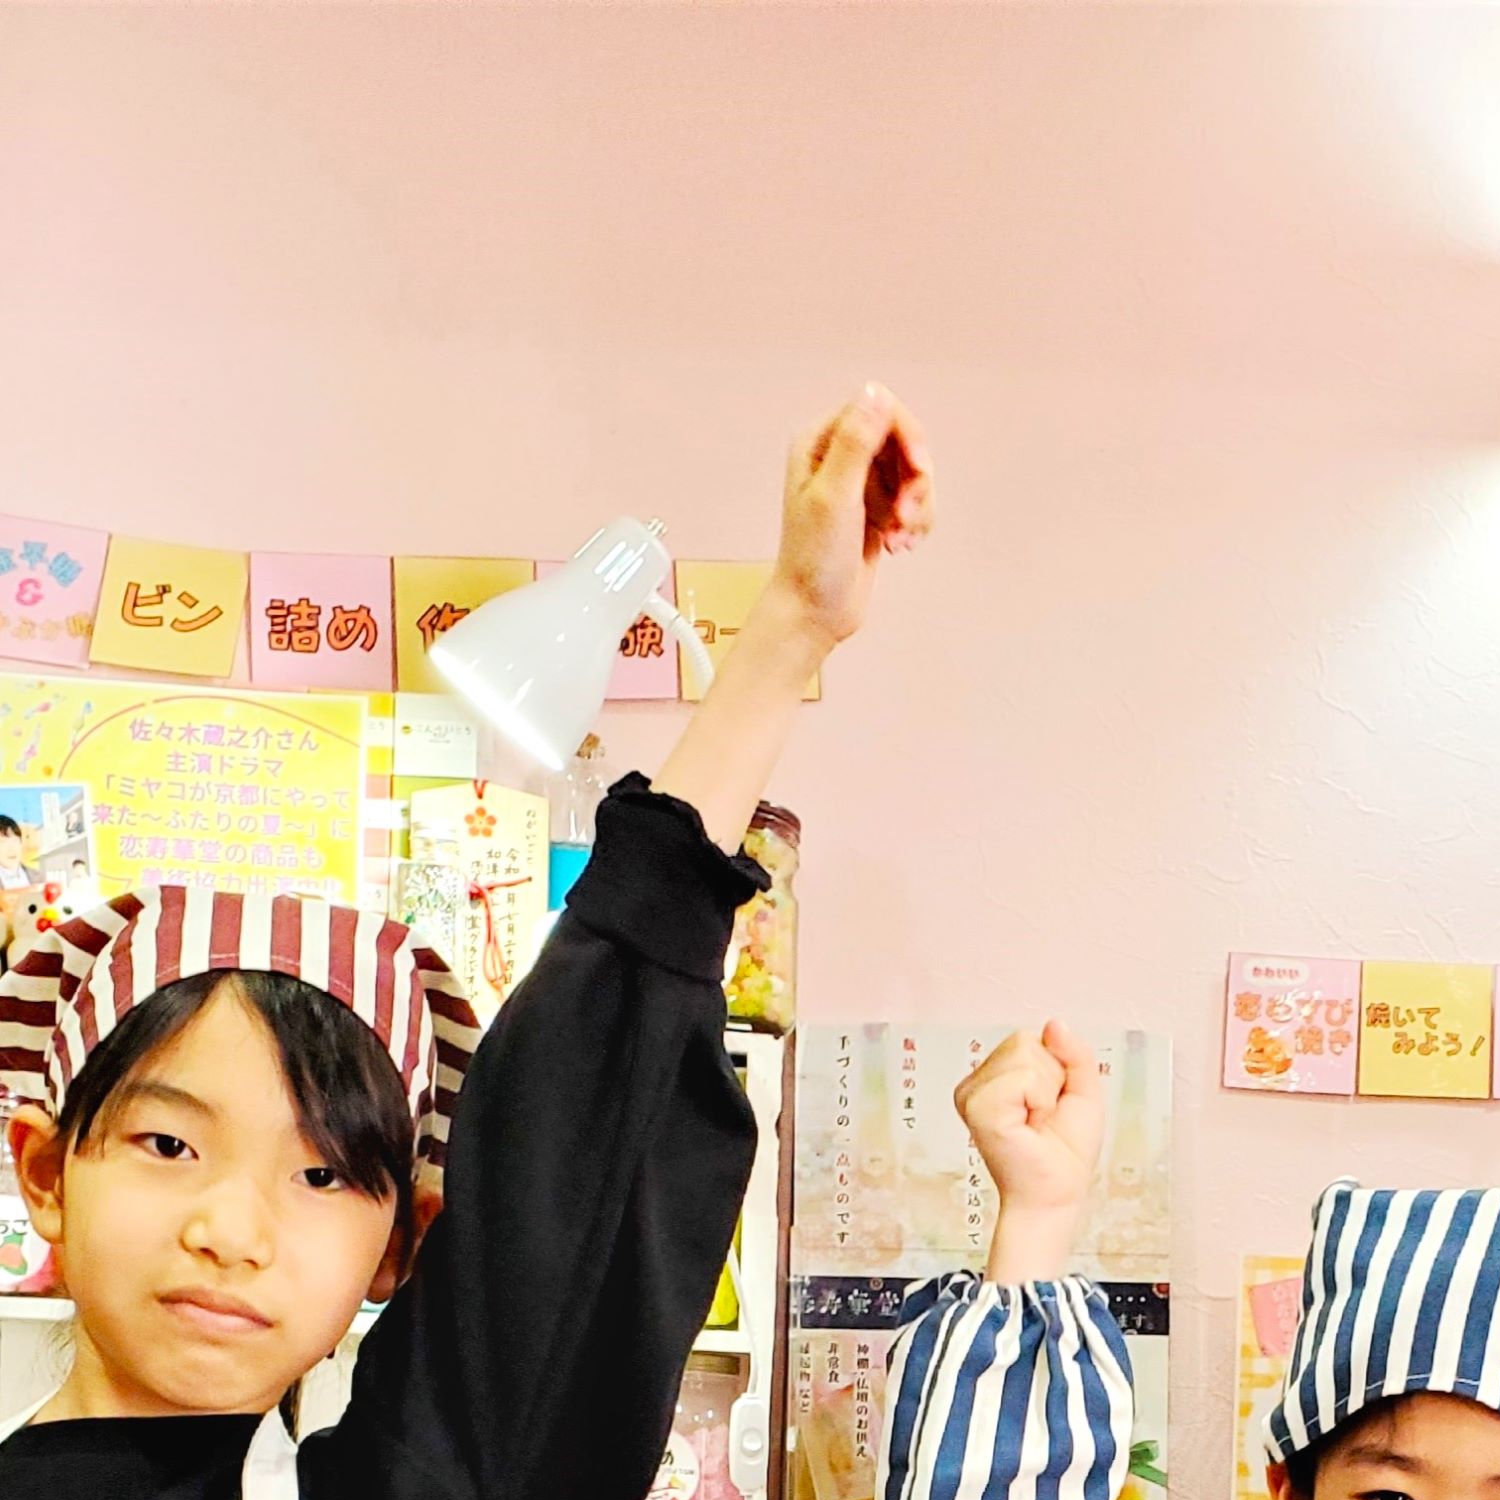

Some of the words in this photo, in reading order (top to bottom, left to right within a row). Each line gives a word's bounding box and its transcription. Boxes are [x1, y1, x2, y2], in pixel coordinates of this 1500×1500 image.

[122, 582, 223, 632] ビン
[267, 601, 377, 652] 詰め
[166, 752, 283, 776] 主演ドラマ
[1366, 1002, 1441, 1029] 焼いて
